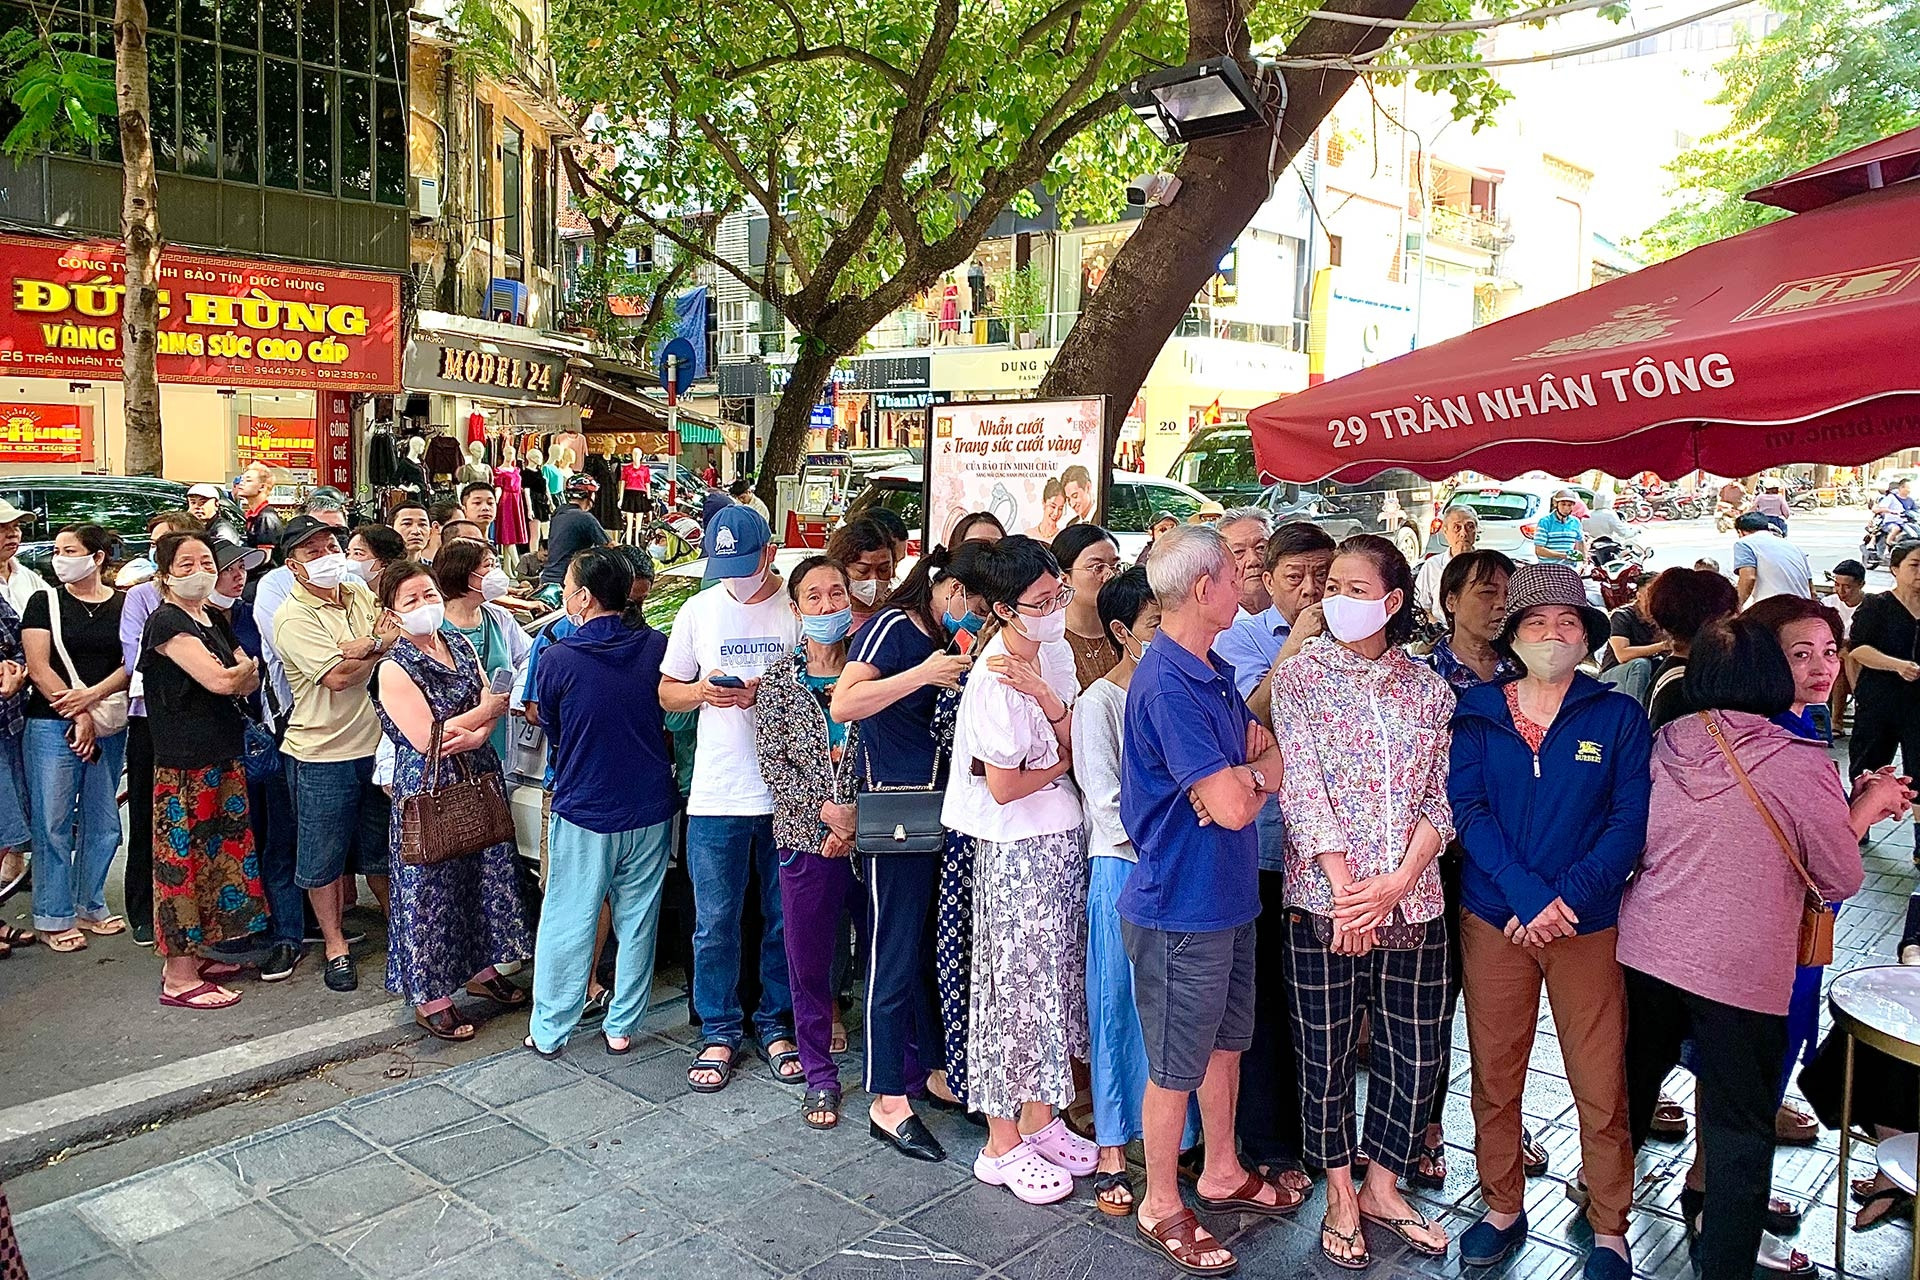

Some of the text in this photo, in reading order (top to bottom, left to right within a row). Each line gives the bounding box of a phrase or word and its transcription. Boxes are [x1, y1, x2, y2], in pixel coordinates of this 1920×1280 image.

[58, 256, 106, 271] CÔNG
[184, 266, 215, 281] BẢO
[219, 271, 242, 285] TÍN
[285, 278, 325, 292] HÙNG
[186, 288, 370, 336] HÙNG
[42, 318, 349, 364] VÀNG ANG SỨC CAO CẤP
[0, 350, 24, 362] 26
[67, 355, 103, 366] NHÂN
[106, 356, 124, 367] TÔ
[1001, 360, 1037, 372] DUNG
[227, 364, 250, 374] TEL:
[442, 347, 551, 391] MODEL 24
[333, 399, 345, 414] GIA
[1326, 353, 1737, 449] 29 TRẦN NHÂN TÔNG
[330, 420, 349, 437] CÔNG
[977, 416, 1044, 437] Nhẫn cưới
[1160, 421, 1177, 431] 20
[333, 441, 347, 460] CHẾ
[943, 435, 1082, 456] & Trang sức cưới vàng
[982, 460, 997, 470] BẢO
[1013, 462, 1034, 470] MINH
[1036, 460, 1058, 470] CHÂU
[334, 466, 347, 483] TÁC
[720, 642, 784, 656] EVOLUTION
